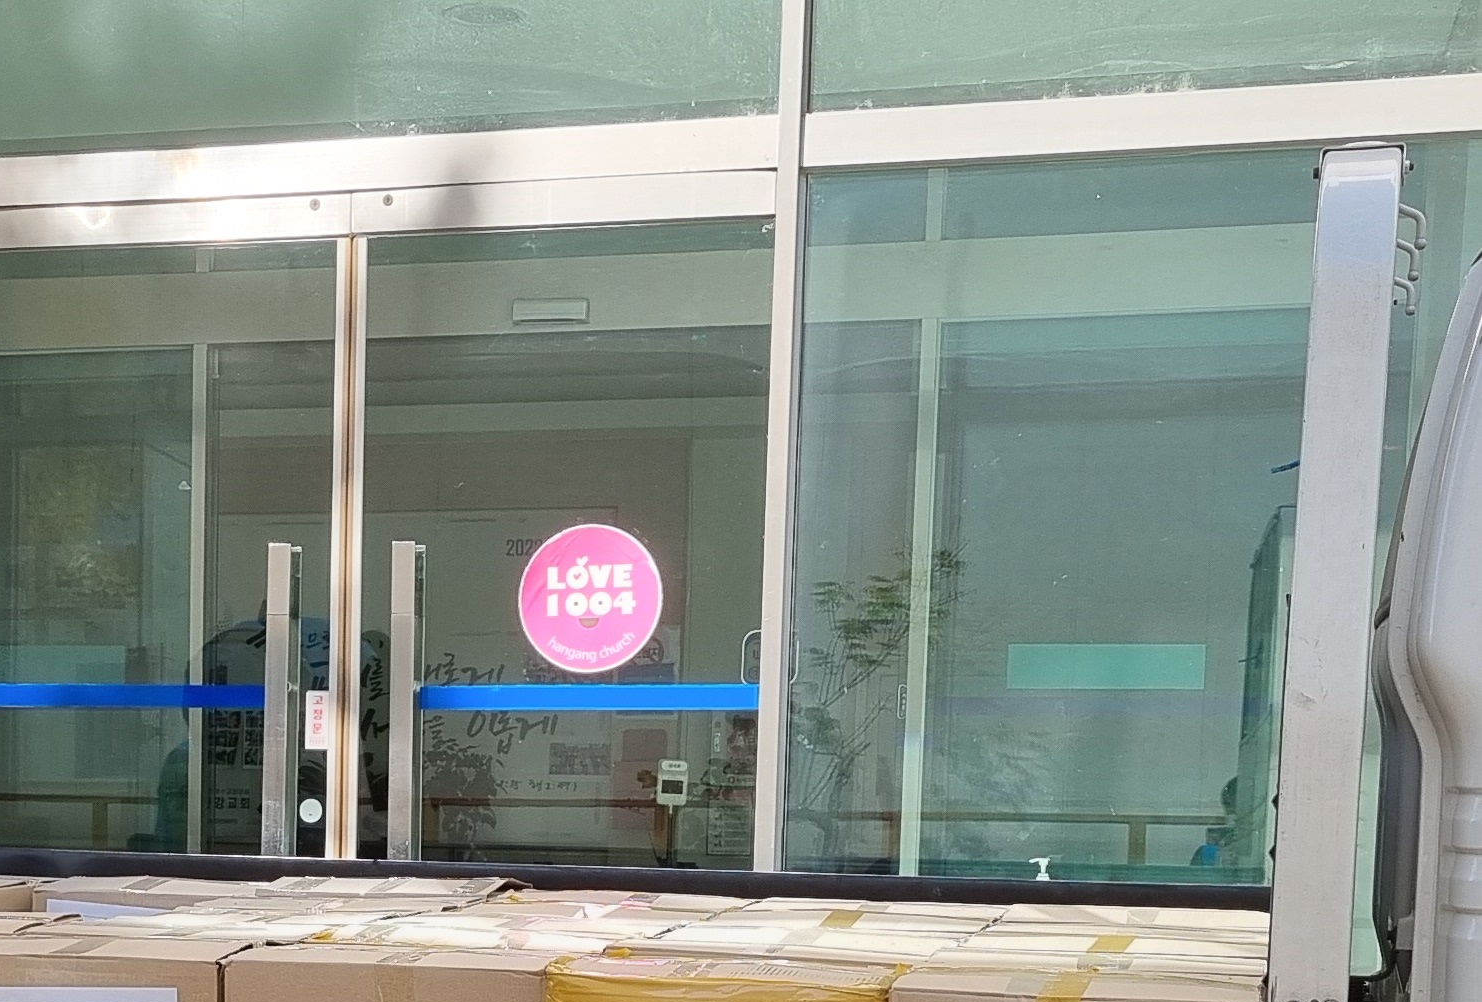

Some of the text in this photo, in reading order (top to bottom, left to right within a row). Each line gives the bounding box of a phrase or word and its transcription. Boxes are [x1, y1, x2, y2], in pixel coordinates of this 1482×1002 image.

[547, 563, 633, 590] LOVE
[546, 591, 637, 617] 1004
[548, 631, 636, 663] hangang church
[312, 695, 324, 735] 고정문
